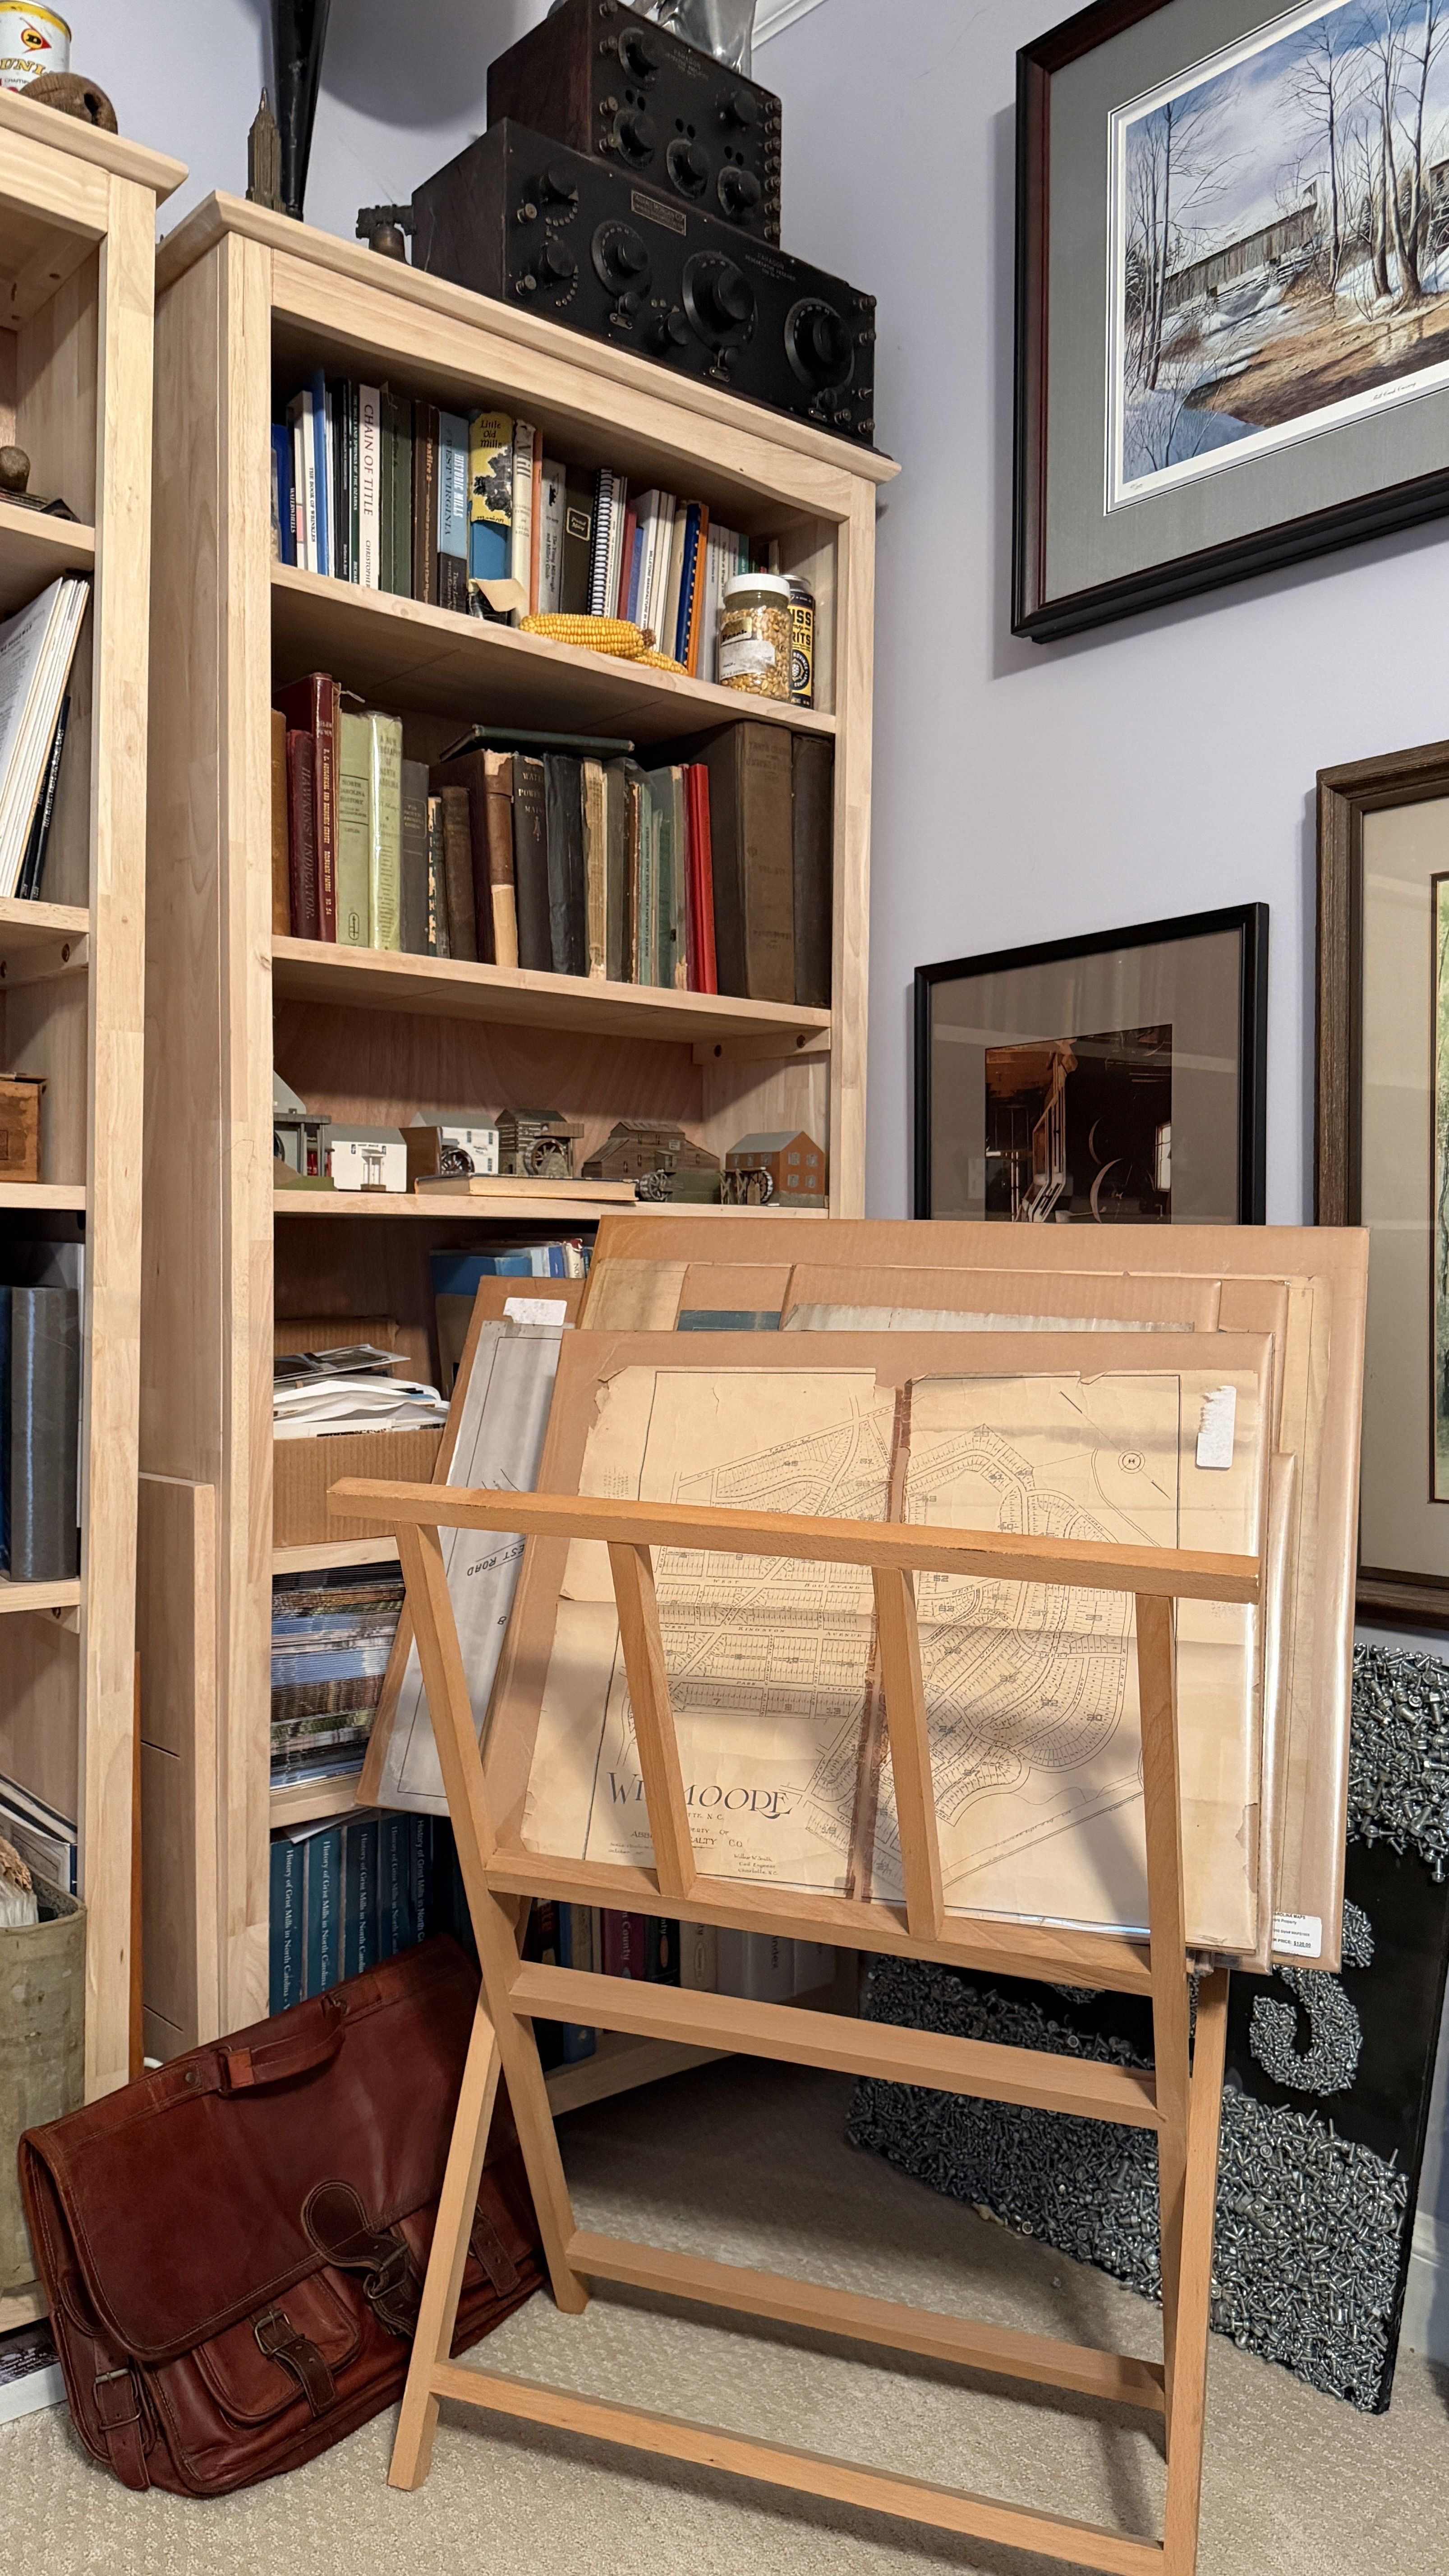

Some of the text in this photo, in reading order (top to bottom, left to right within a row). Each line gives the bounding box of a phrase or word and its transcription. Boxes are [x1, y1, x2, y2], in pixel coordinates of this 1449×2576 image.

[480, 420, 501, 429] Little
[363, 405, 373, 516] CHAIN OF TITLE
[453, 453, 464, 518] HISTORIC MILLS
[342, 779, 361, 787] NORTH
[467, 1556, 497, 1576] ROAD
[415, 1820, 424, 1848] History
[322, 1841, 331, 1869] History
[359, 1833, 368, 1861] History
[417, 1850, 423, 1858] of
[284, 1850, 294, 1877] History
[322, 1870, 330, 1879] of
[285, 1879, 293, 1890] of
[359, 1891, 368, 1910] Mills
[285, 1910, 293, 1933] Mills
[283, 1940, 291, 1964] North
[321, 1929, 329, 1954] North
[621, 1921, 631, 1960] County
[283, 1965, 291, 1997] Carolina
